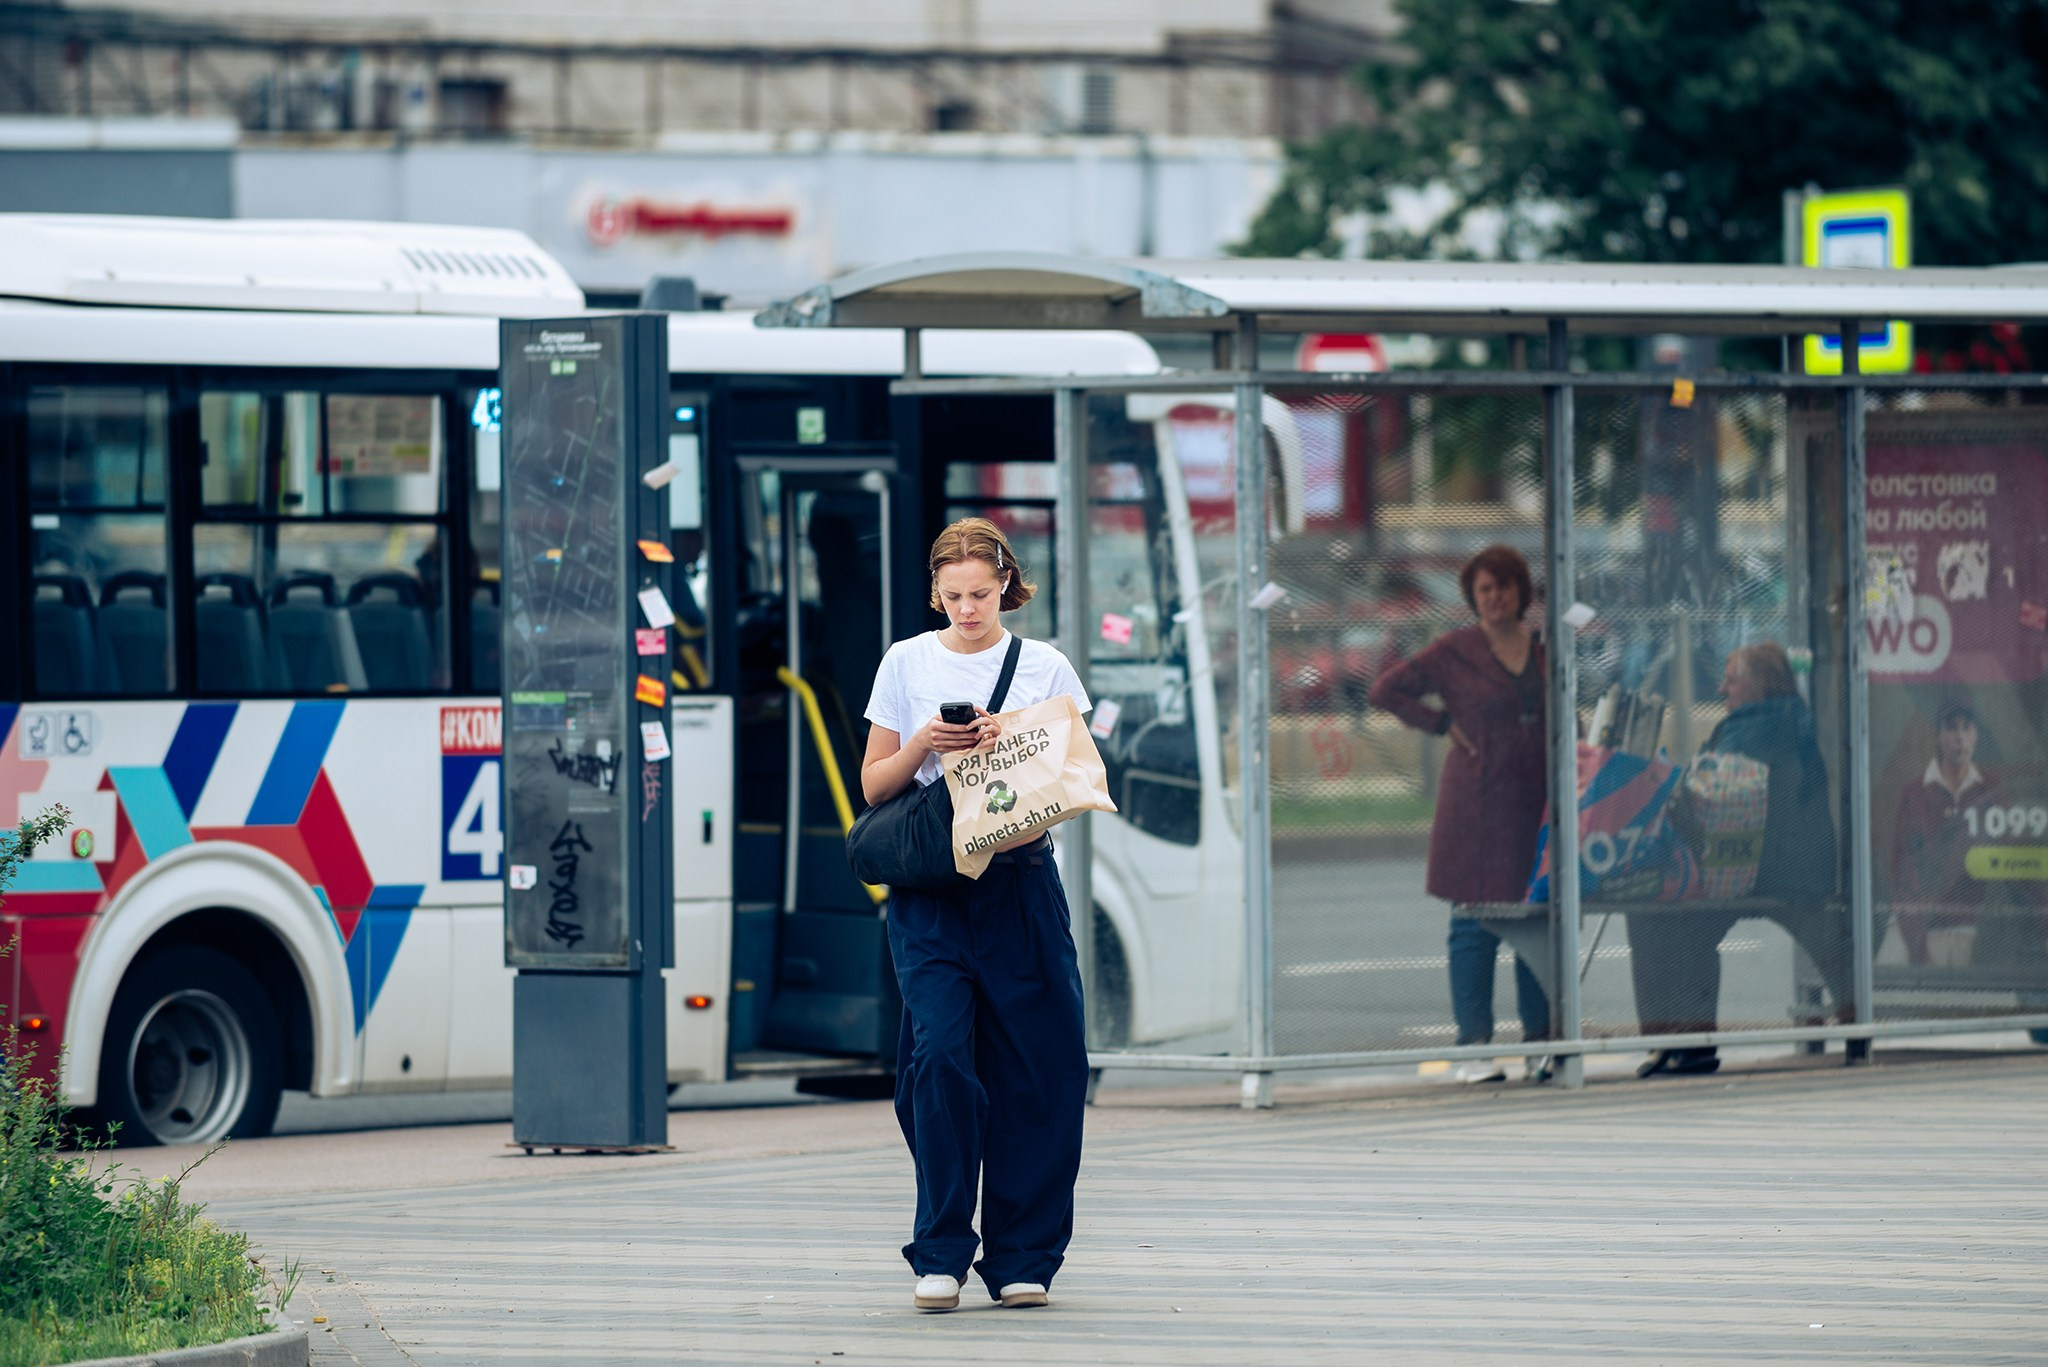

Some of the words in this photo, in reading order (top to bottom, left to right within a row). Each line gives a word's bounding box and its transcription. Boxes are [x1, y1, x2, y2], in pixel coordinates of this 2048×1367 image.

[1866, 474, 1996, 497] олстовка
[1896, 500, 1987, 531] любой
[990, 740, 1050, 773] ВЫБОР
[448, 760, 504, 876] 4
[964, 801, 1062, 855] planeta-sh.ru
